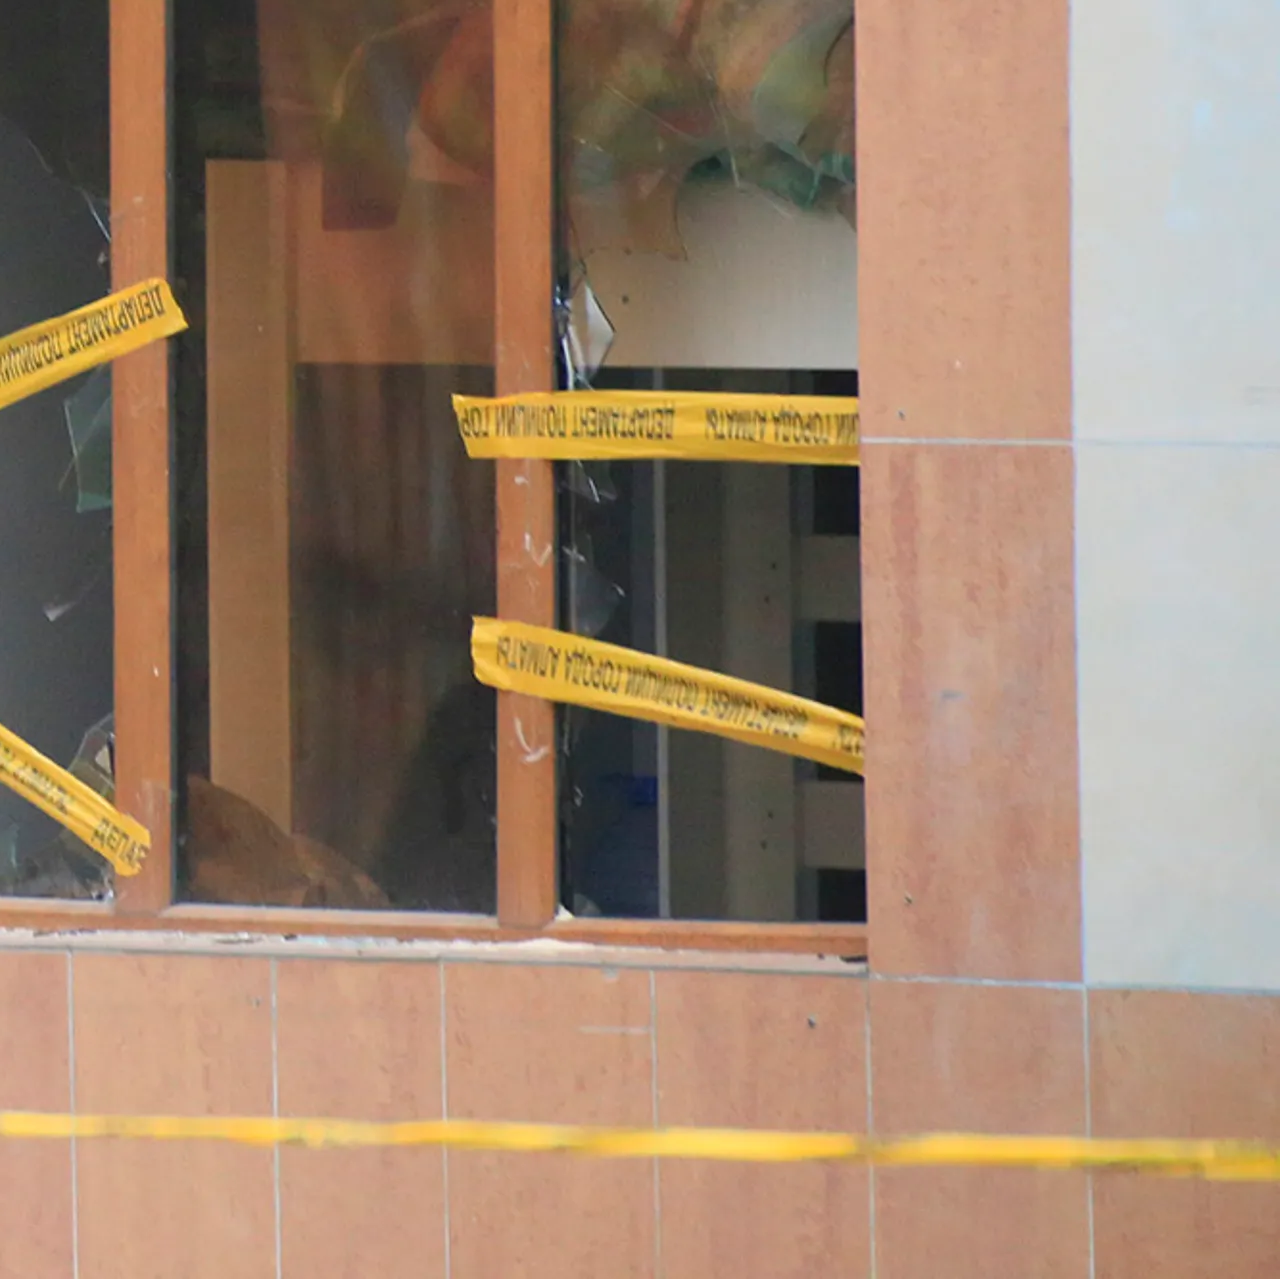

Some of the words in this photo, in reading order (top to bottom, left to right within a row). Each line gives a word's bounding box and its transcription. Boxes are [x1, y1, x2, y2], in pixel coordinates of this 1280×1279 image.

[67, 284, 166, 355] ДЕПАРТАМЕНТ
[495, 403, 567, 438] ПОЛИЦИИ
[572, 402, 676, 441] ДЕПАРТАМЕНТ
[705, 406, 766, 442] АЛМАТЫ
[496, 635, 561, 679] АЛМАТЫ
[564, 645, 623, 694] ГОРОДА
